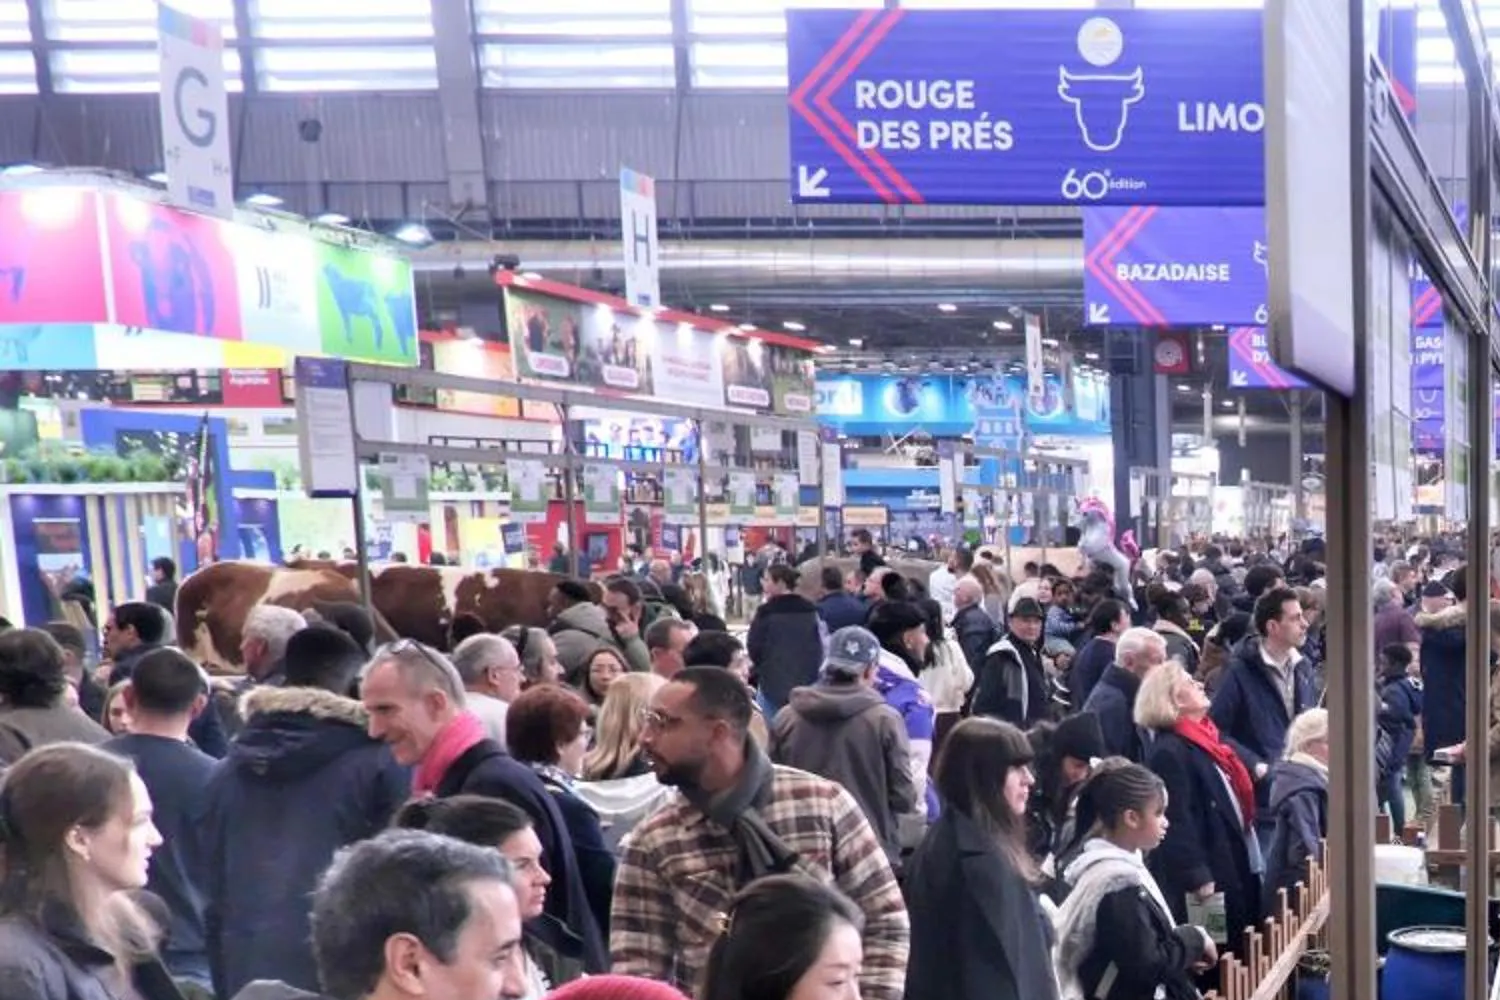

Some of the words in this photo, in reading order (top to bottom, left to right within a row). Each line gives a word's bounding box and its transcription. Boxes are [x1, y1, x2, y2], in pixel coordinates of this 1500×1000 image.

[173, 65, 217, 148] G
[855, 79, 976, 110] ROUGE
[857, 120, 922, 150] DES
[928, 111, 1013, 150] PRÉS
[1178, 102, 1265, 132] LIMO
[631, 208, 651, 268] H
[1116, 263, 1231, 281] BAZADAISE
